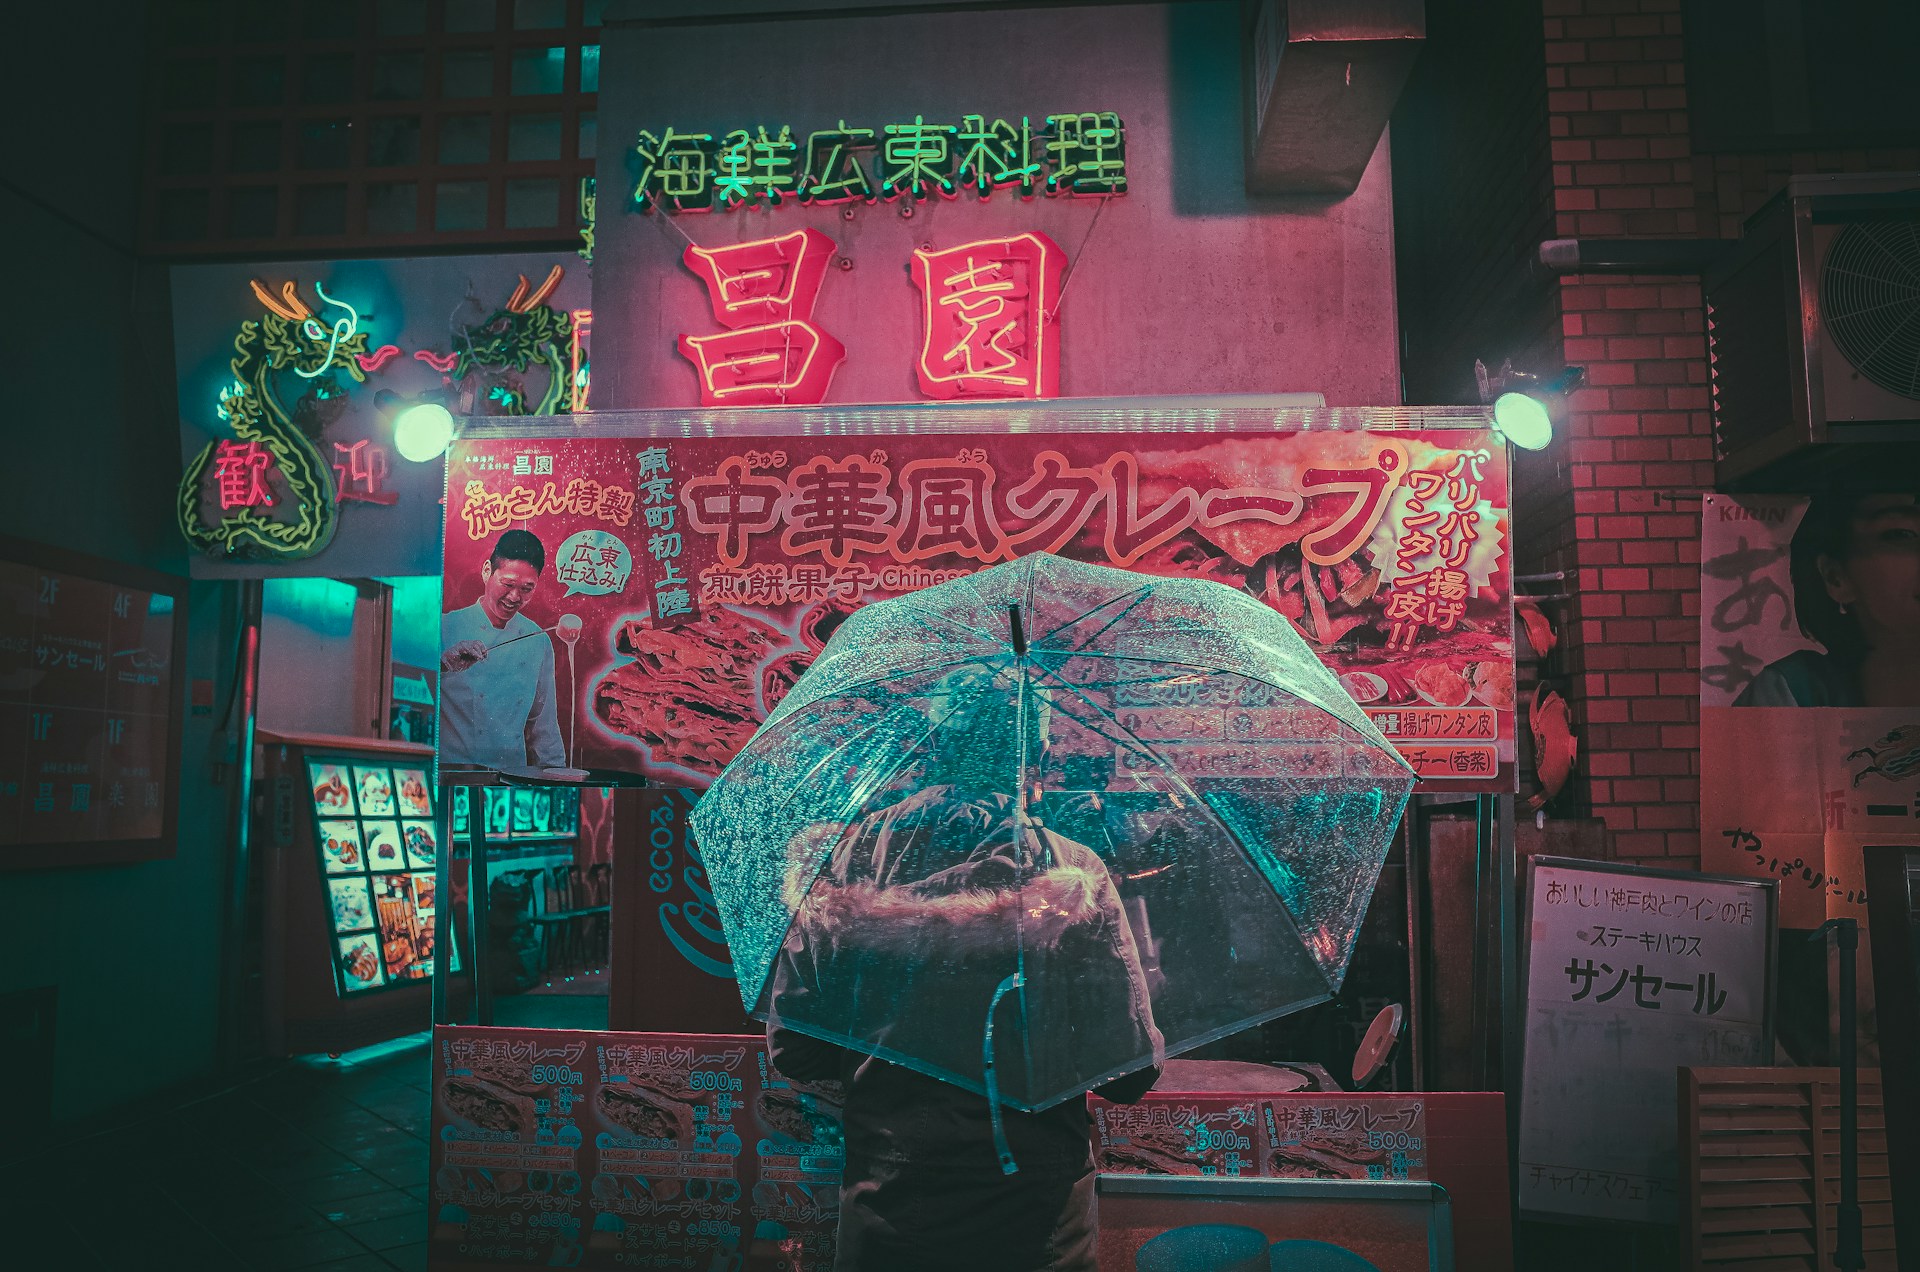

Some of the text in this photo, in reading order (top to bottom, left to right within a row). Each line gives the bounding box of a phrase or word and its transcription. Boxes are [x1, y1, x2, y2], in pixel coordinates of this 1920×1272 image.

[635, 111, 1127, 213] 海鮮広東料理
[678, 227, 1068, 406] 昌園
[513, 455, 553, 475] 昌園
[463, 480, 635, 541] 施さん特製
[683, 442, 1406, 564] 中華風クレープ
[1719, 505, 1787, 524] KIRIN
[636, 446, 693, 619] 南京町初上陸
[1425, 452, 1490, 631] パリパリ揚げ
[571, 542, 622, 570] 広東
[39, 576, 61, 606] 2F
[702, 564, 877, 604] 煎餅果子
[113, 593, 132, 619] 4F
[35, 645, 106, 672] サンセール
[32, 713, 53, 741] 1F
[107, 718, 125, 744] 1F
[1545, 880, 1753, 926] おいしい神戸肉とワインの店
[1589, 925, 1703, 957] ステーキハウス
[1563, 957, 1728, 1016] サンセール
[451, 1039, 586, 1066] 中華風クレープ
[606, 1044, 746, 1071] 中華風クレープ
[532, 1065, 583, 1084] 500円
[689, 1071, 743, 1091] 500円
[1105, 1103, 1253, 1129] 中華風クレープ
[1275, 1103, 1423, 1131] 中華風クレープ
[1196, 1130, 1250, 1150] 500円
[1369, 1131, 1422, 1150] 500円
[470, 1214, 509, 1229] アサヒ
[470, 1227, 561, 1243] スーパードライ
[625, 1223, 666, 1238] アサヒ
[469, 1244, 538, 1261] ハイボール
[625, 1236, 724, 1252] スーパードライ
[624, 1253, 697, 1269] ハイボール
